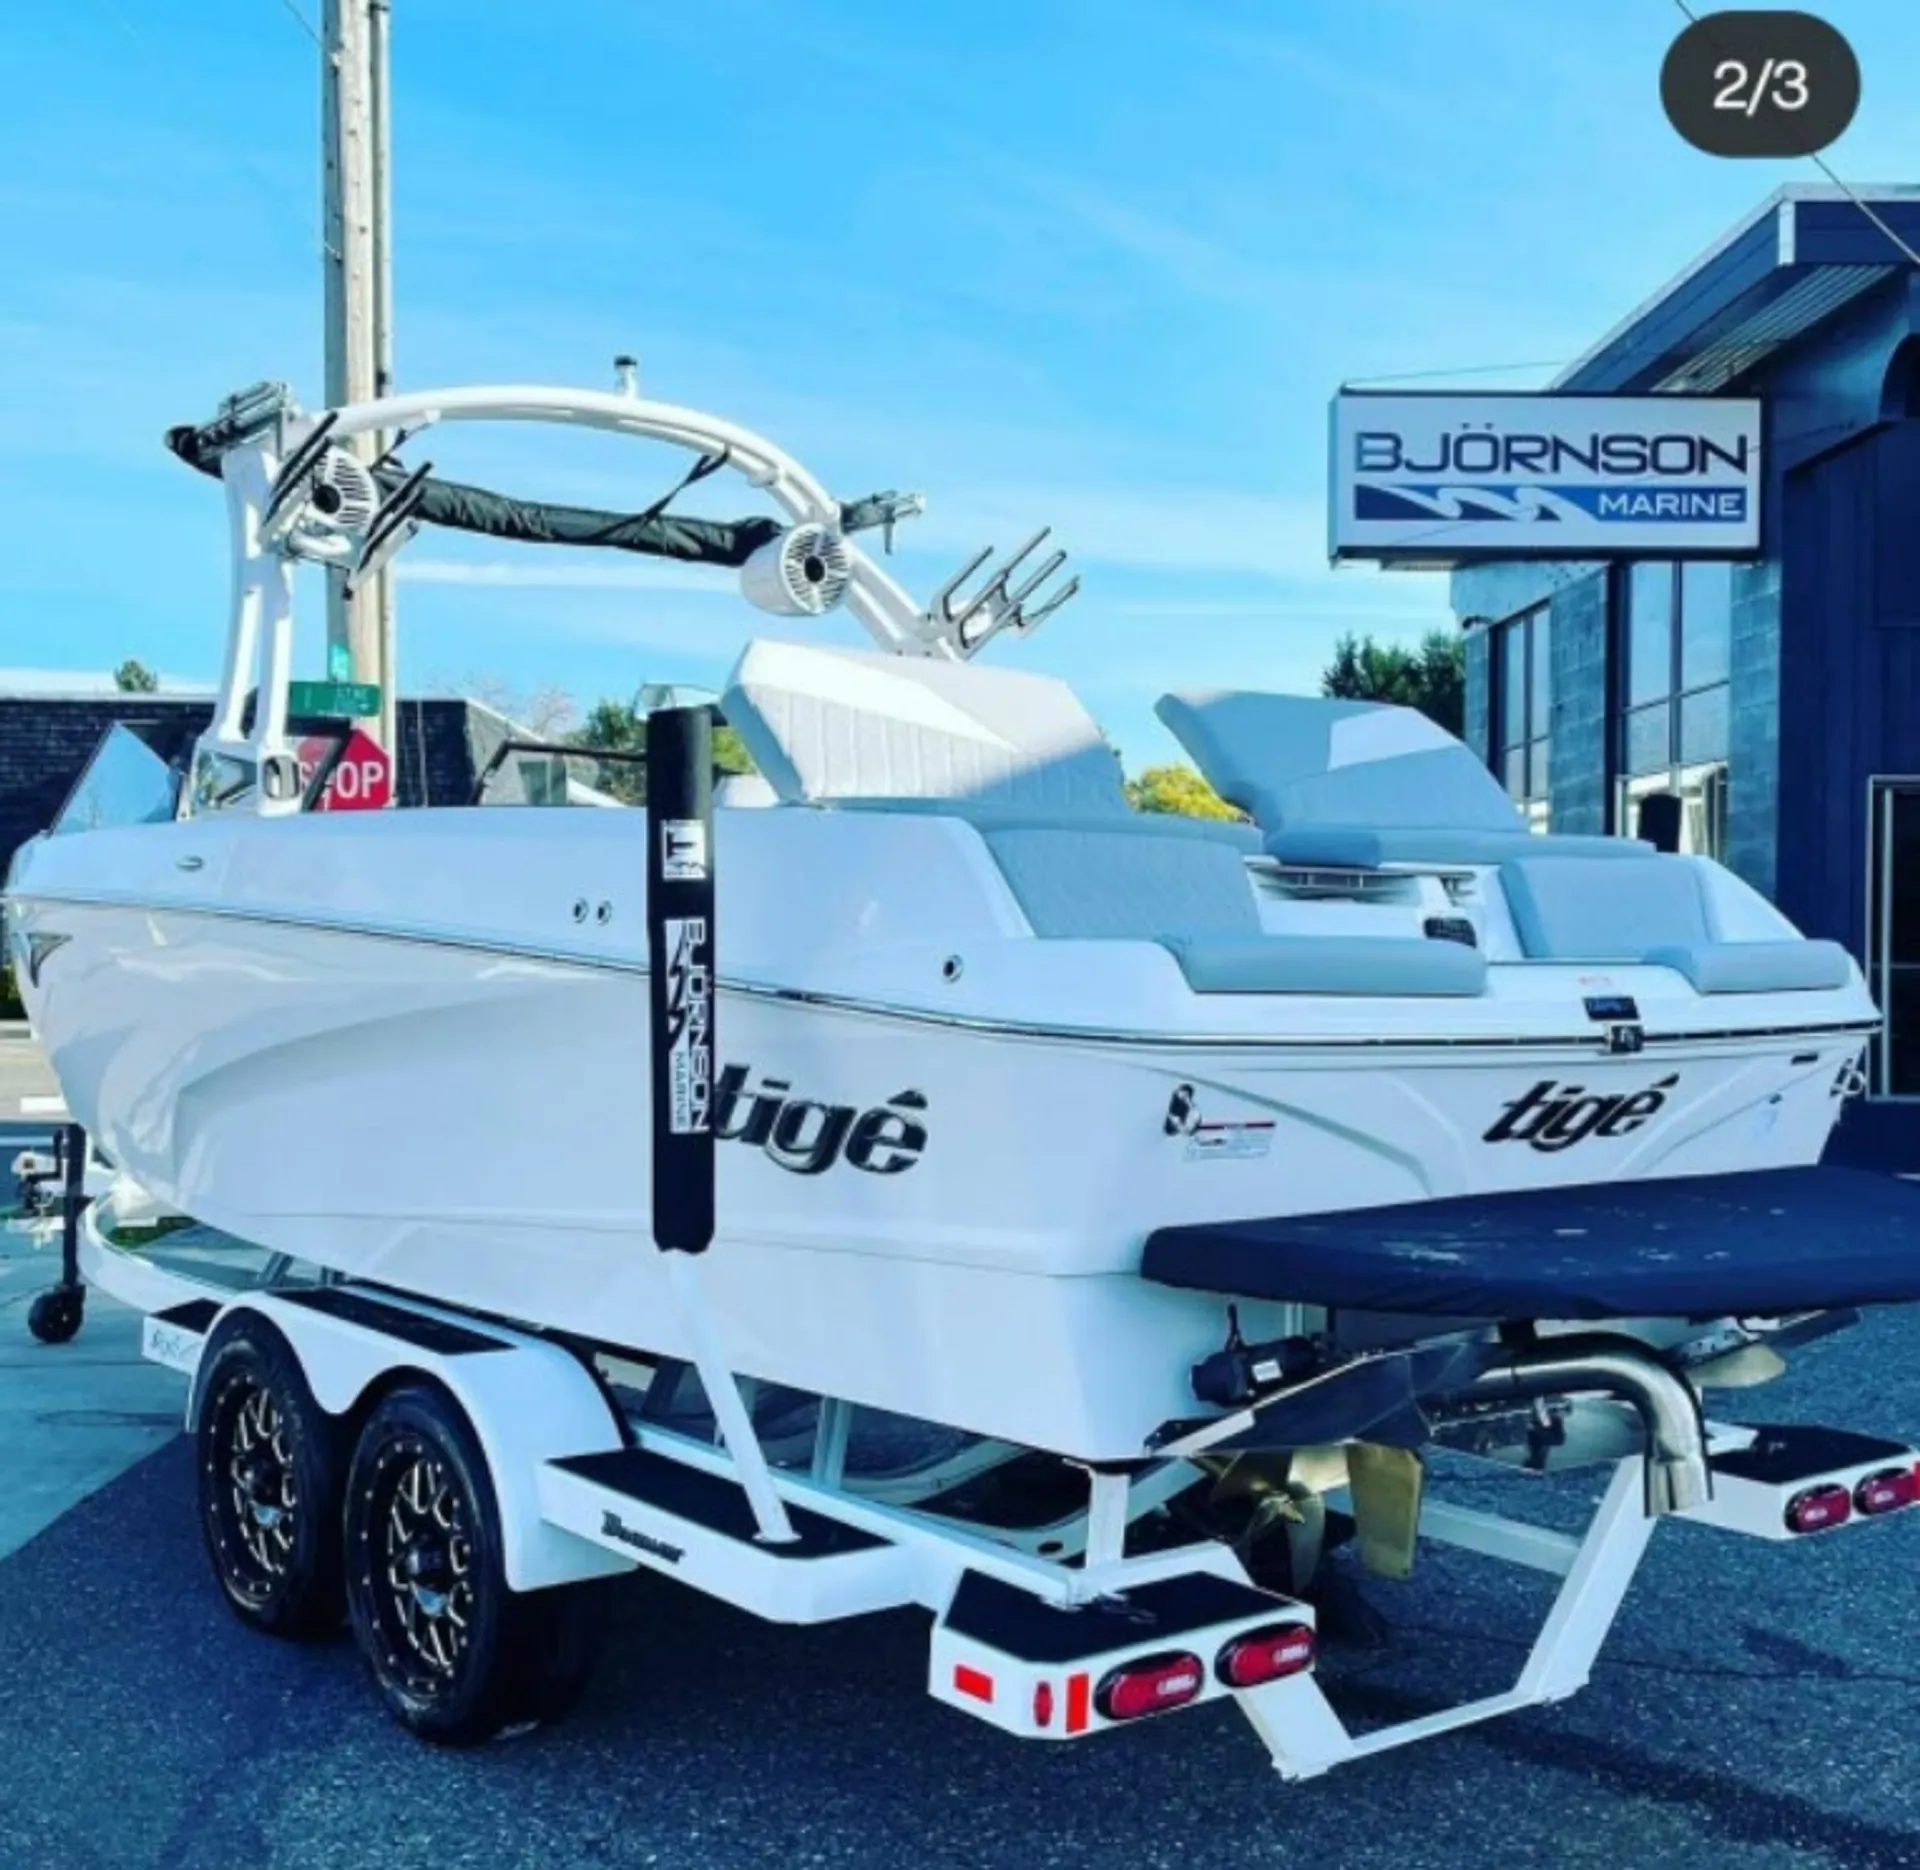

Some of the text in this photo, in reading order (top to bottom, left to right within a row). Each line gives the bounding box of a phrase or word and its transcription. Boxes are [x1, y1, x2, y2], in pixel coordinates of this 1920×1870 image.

[1355, 422, 1748, 475] BJÖRNSON
[1600, 492, 1742, 517] MARINE
[1481, 1072, 1681, 1153] tigé
